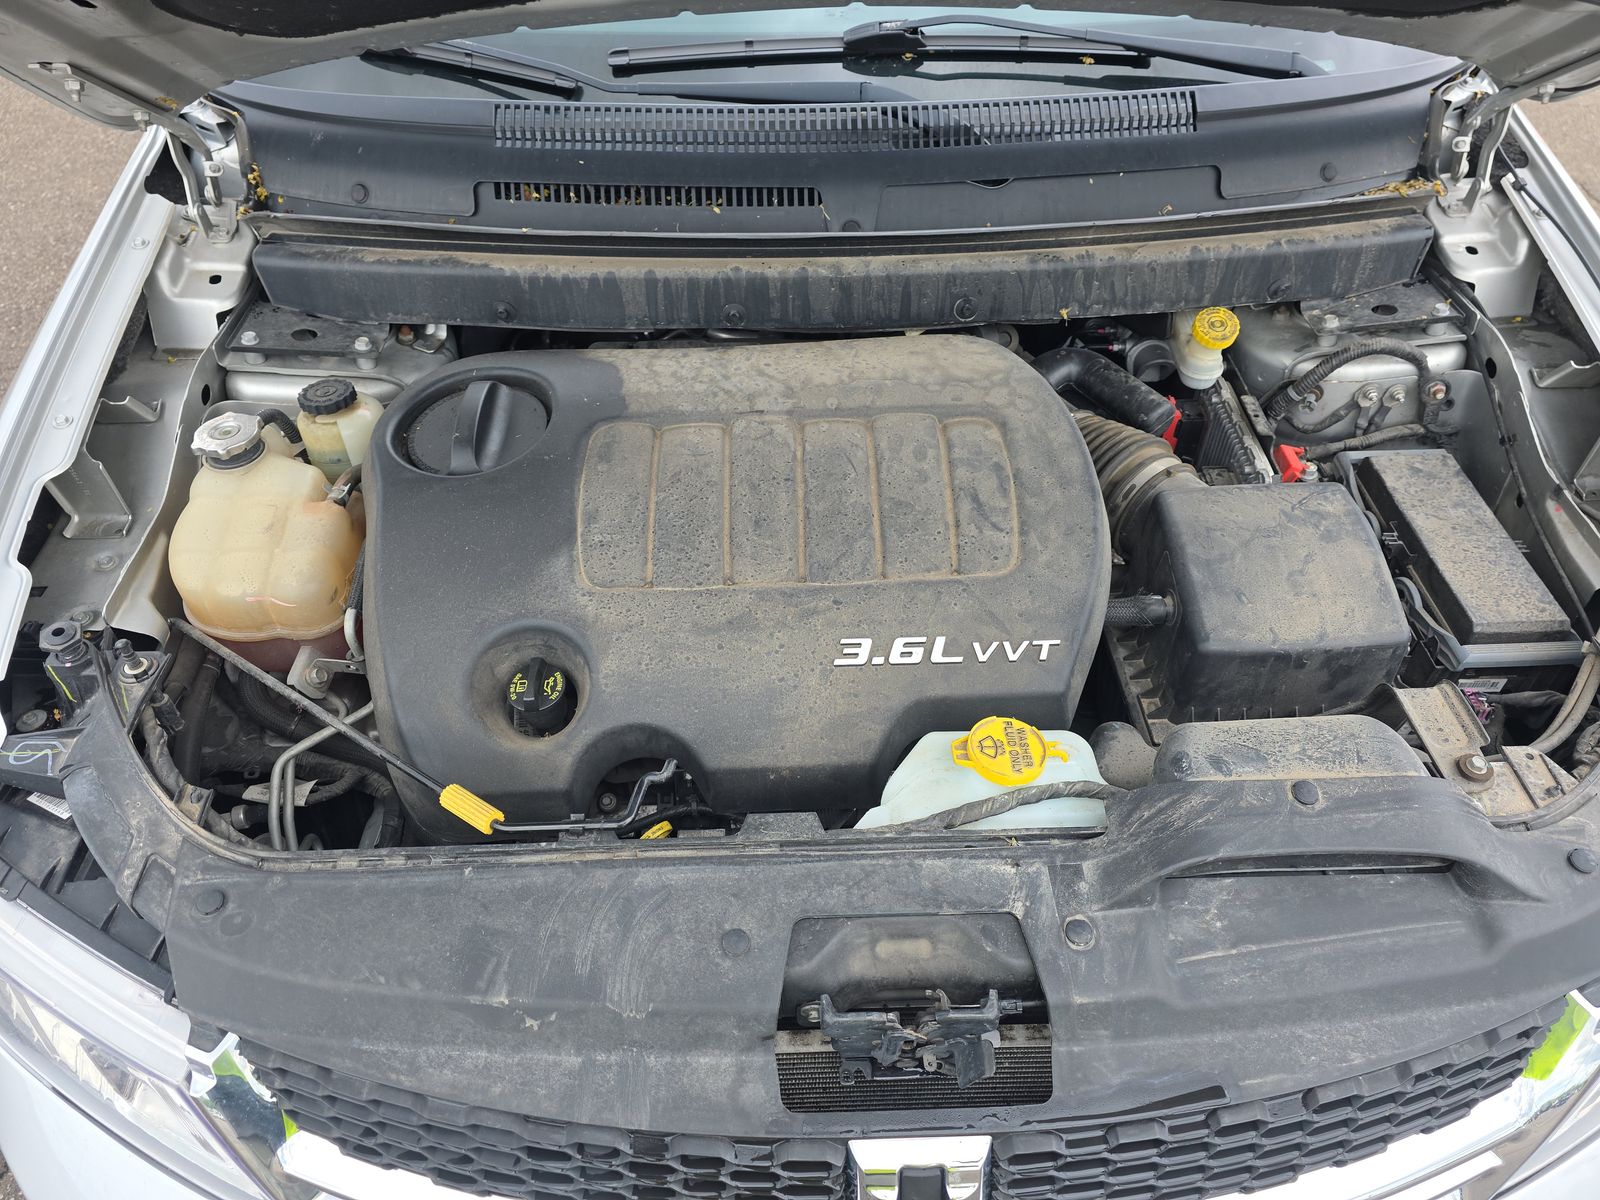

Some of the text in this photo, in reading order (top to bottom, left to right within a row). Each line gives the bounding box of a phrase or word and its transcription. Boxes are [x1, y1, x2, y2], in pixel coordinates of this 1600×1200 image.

[833, 636, 1062, 667] 3.6L VVT
[549, 671, 563, 700] ENGINE OIL
[1003, 720, 1024, 775] FLUID ONLY
[1016, 727, 1034, 769] WASHER
